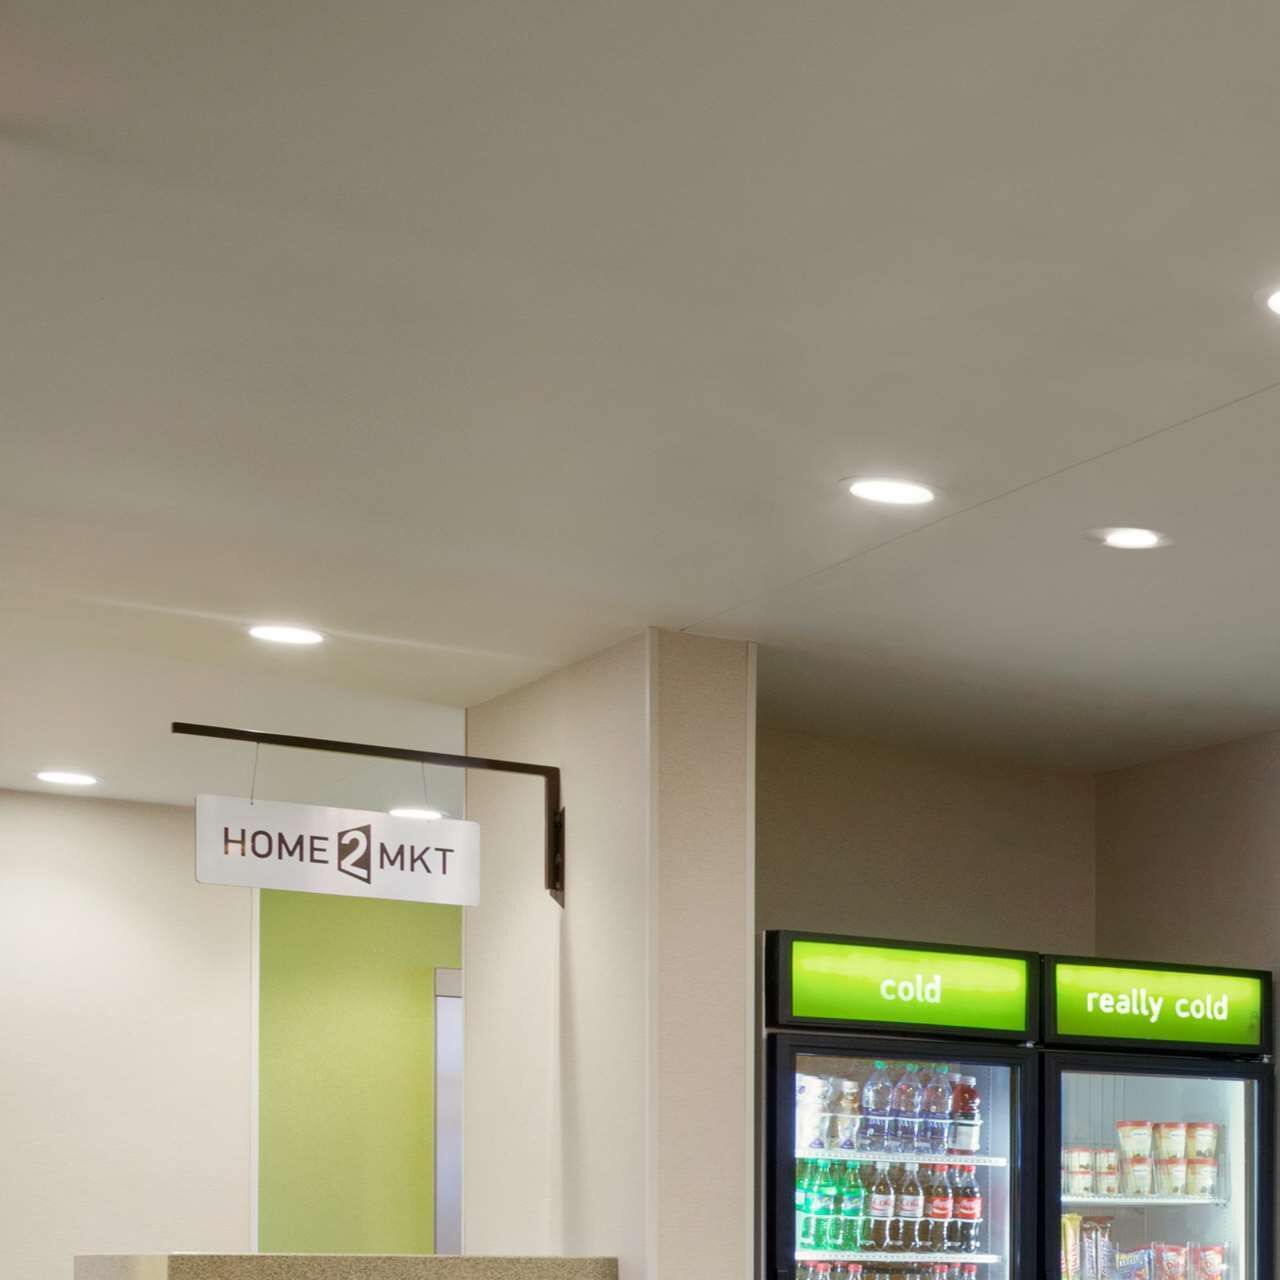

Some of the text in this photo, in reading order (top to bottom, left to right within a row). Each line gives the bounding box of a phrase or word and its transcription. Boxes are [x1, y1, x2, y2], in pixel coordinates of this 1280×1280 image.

[223, 827, 454, 882] HOME 2 MKT
[880, 975, 941, 1003] cold
[1086, 988, 1229, 1023] really cold
